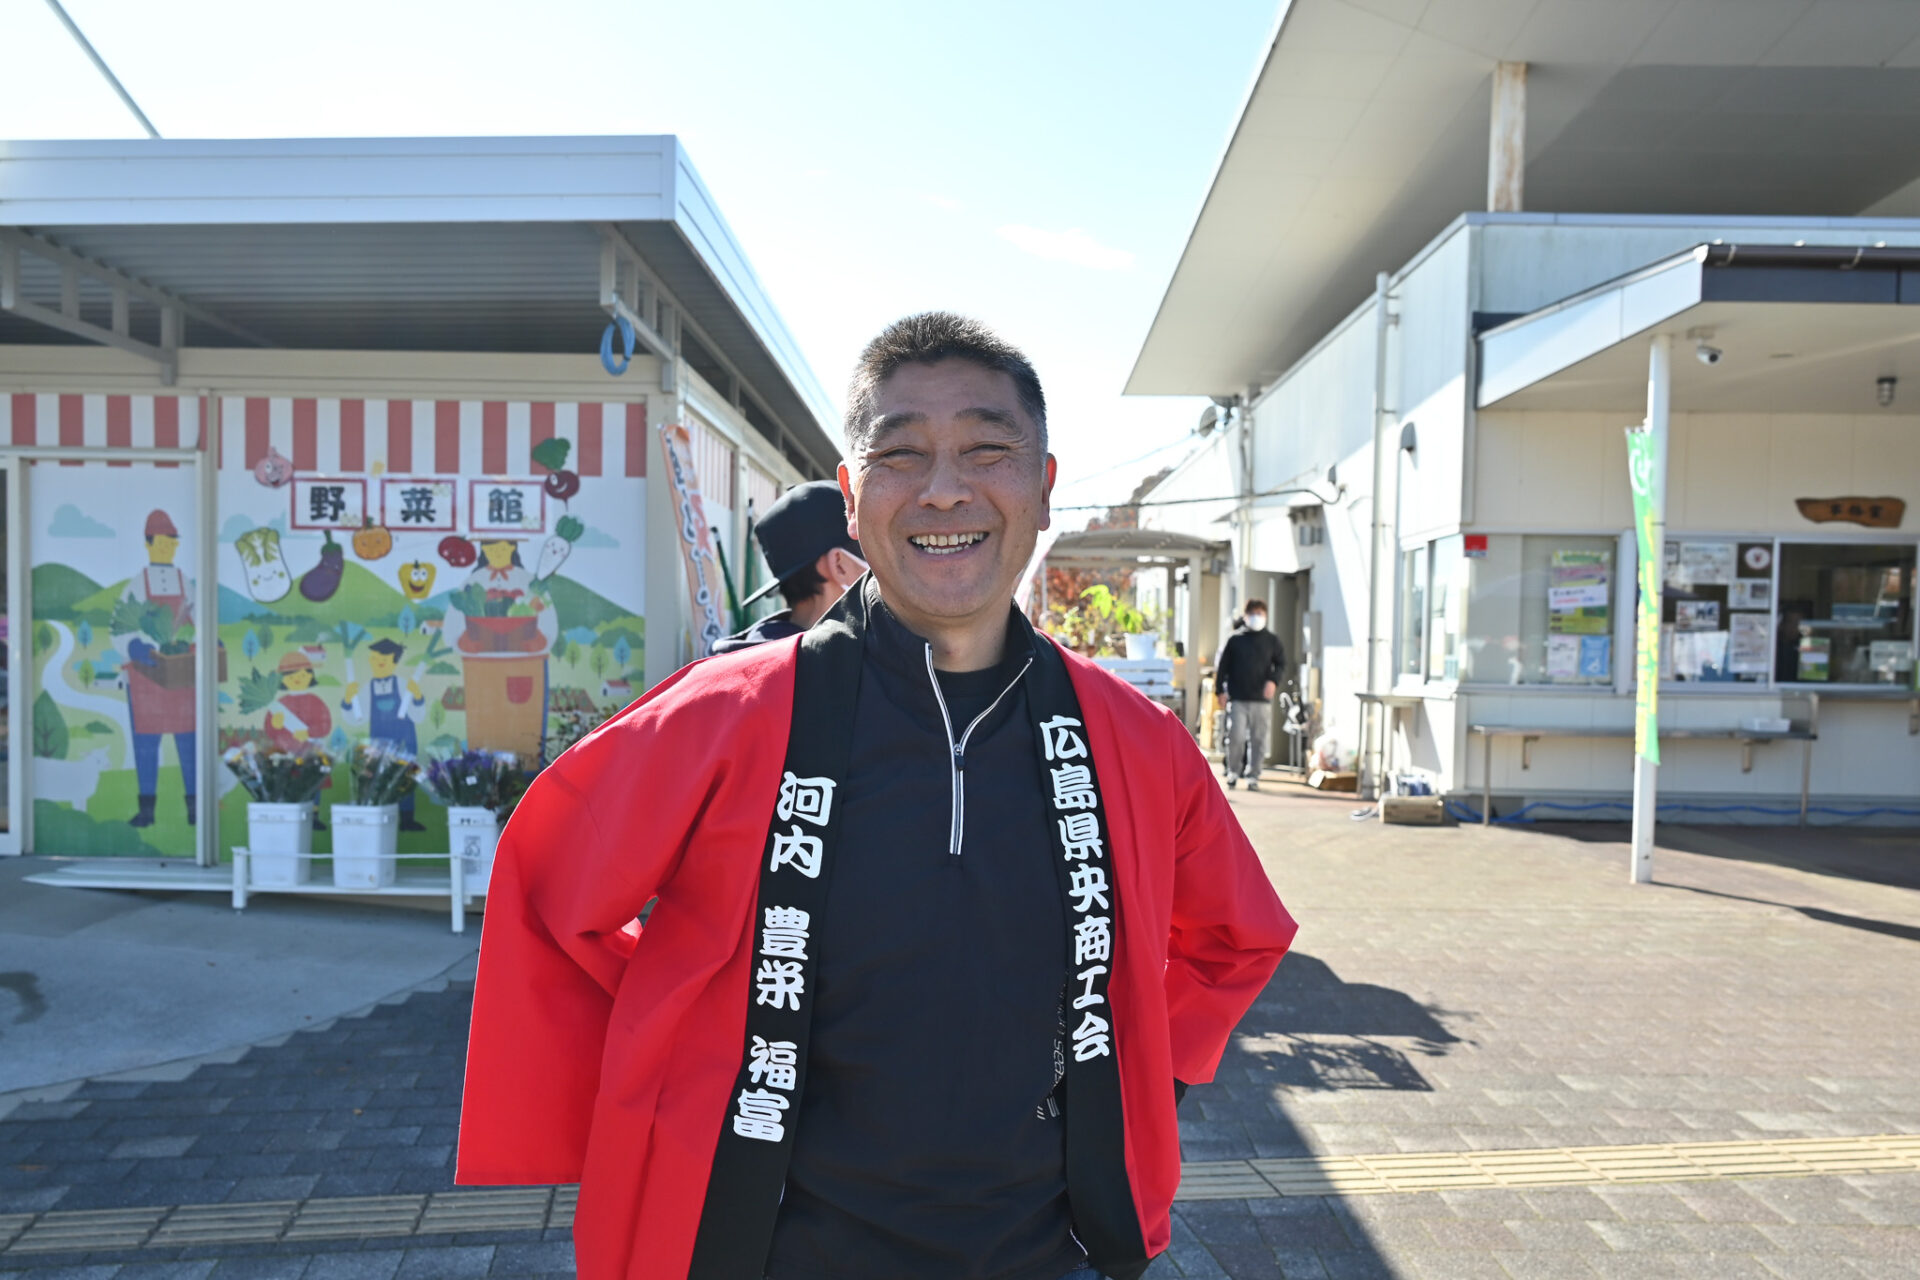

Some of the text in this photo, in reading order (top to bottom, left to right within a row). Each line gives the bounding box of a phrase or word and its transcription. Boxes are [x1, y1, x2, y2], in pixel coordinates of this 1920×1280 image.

[309, 486, 524, 523] 野菜館
[733, 771, 837, 1143] 河内 豊栄 福富
[1039, 715, 1111, 1062] 広島県央商工会
